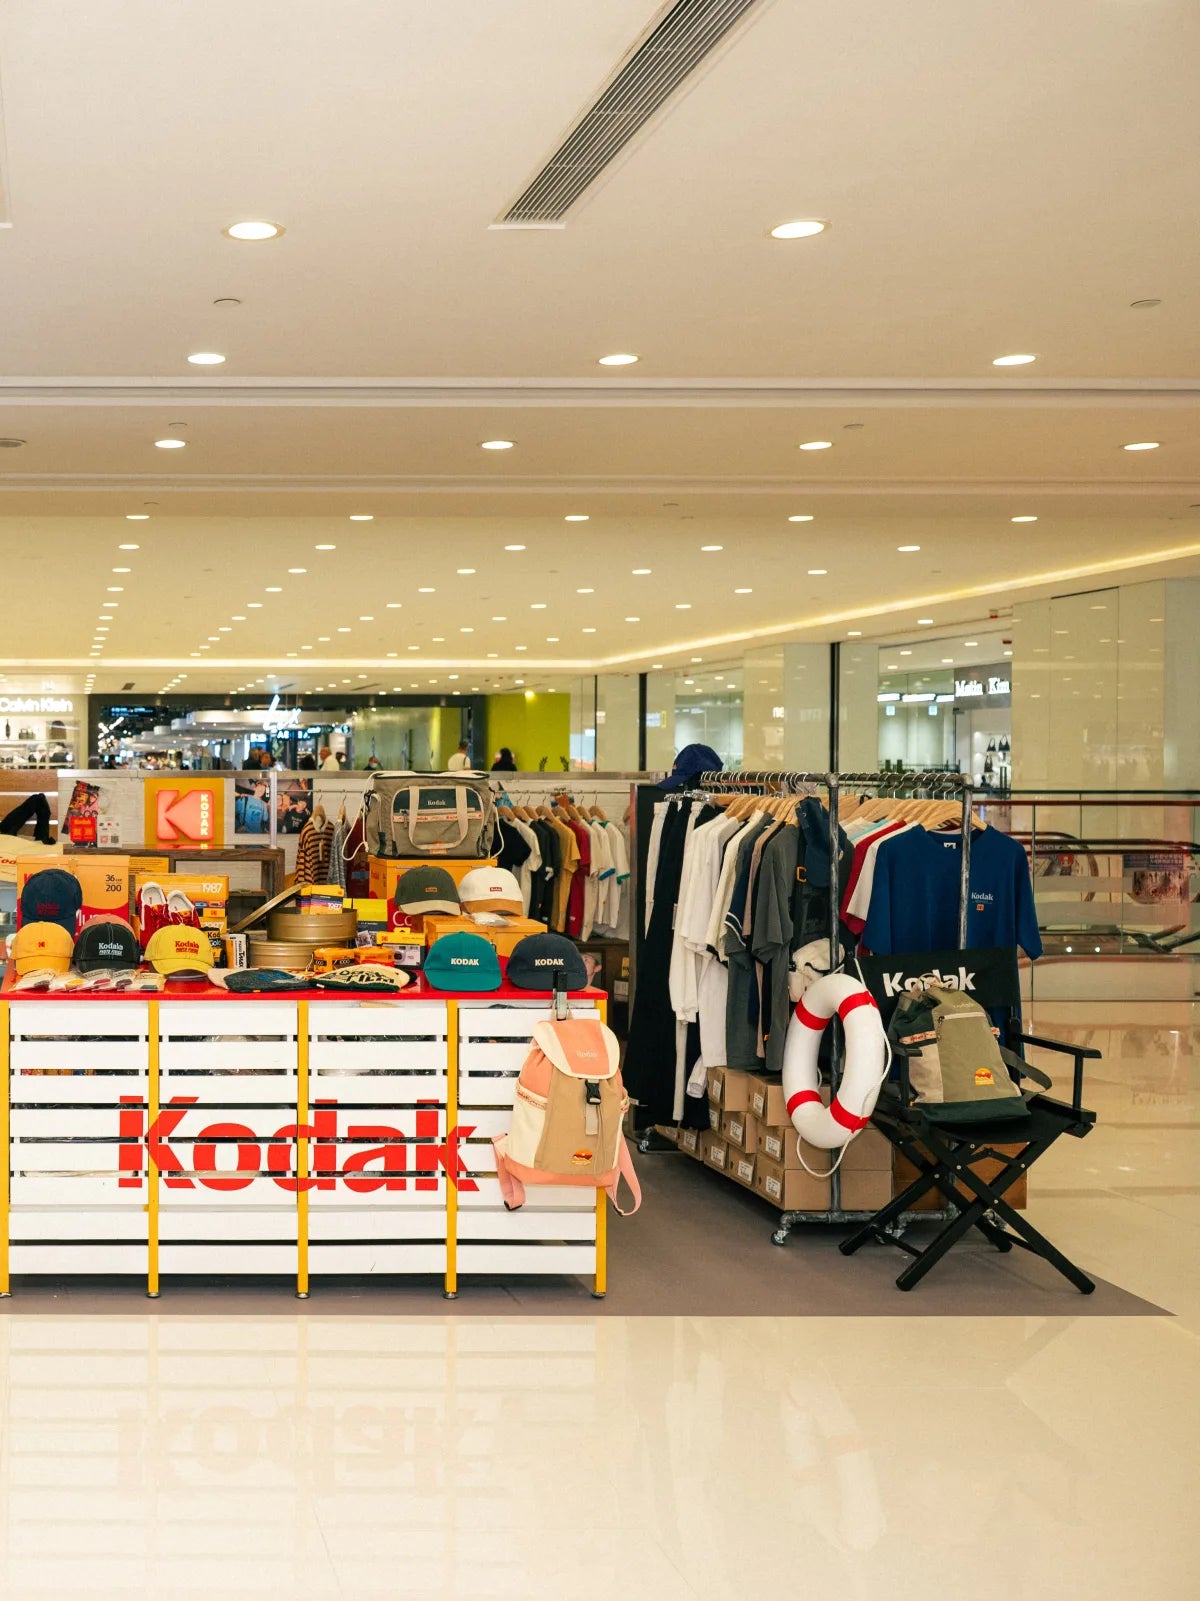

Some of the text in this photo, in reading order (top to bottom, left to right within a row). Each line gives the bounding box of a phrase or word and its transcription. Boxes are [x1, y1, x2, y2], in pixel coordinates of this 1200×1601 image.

[200, 793, 209, 836] KODAK
[105, 884, 122, 892] 200
[201, 882, 223, 893] 1987
[971, 892, 994, 901] Kodak
[98, 942, 123, 951] Kodak
[451, 957, 480, 966] KODAK
[535, 958, 564, 967] KODAK
[118, 1095, 480, 1193] Kodak
